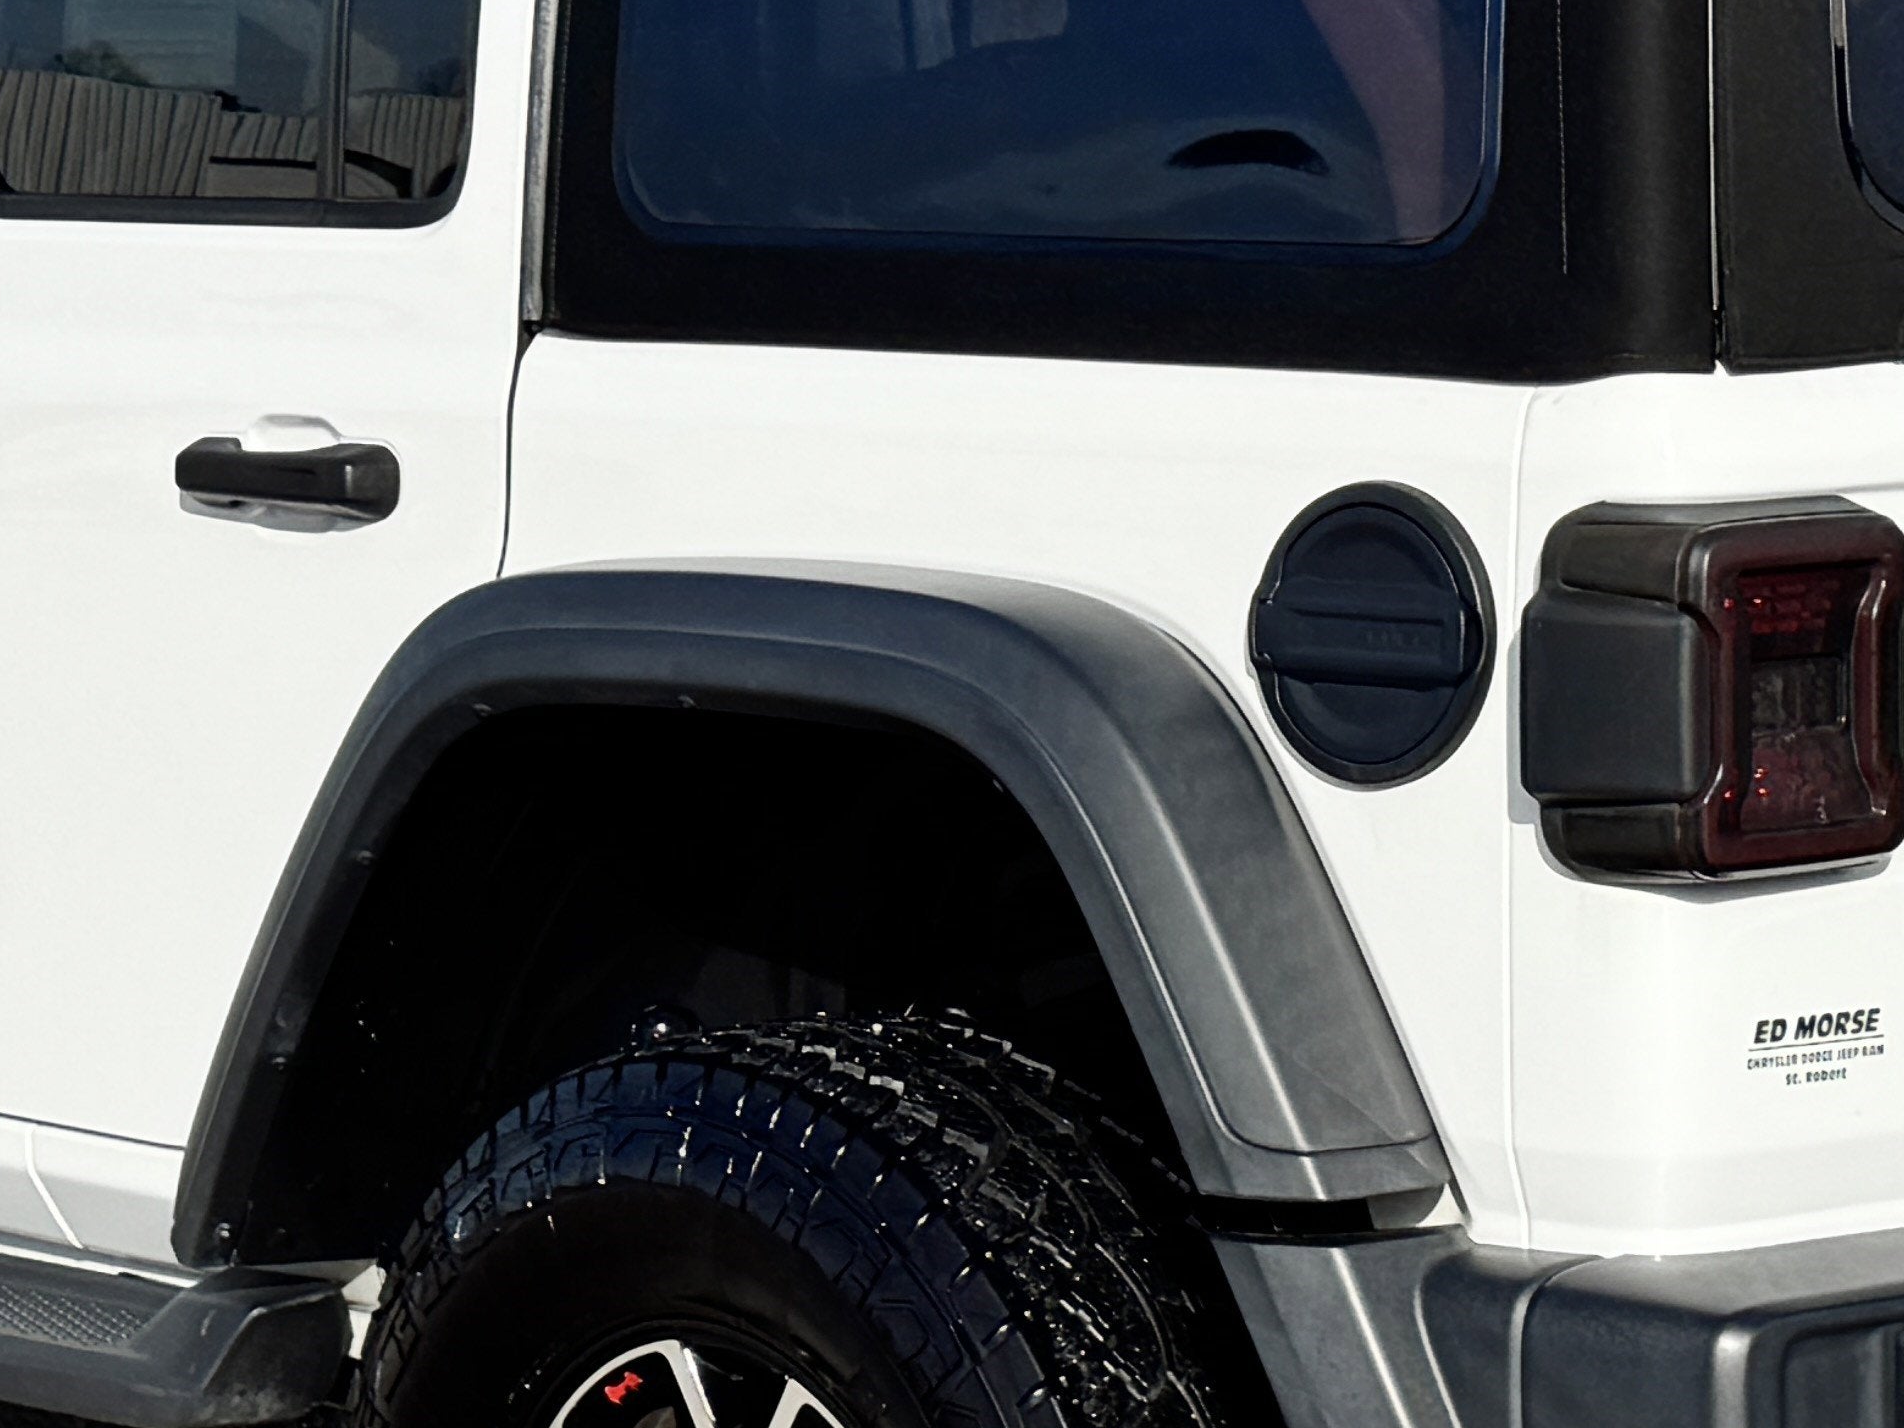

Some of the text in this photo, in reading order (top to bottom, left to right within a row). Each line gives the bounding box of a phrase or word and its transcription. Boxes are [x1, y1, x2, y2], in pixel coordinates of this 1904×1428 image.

[1753, 1007, 1881, 1045] ED MORSE
[1836, 1047, 1860, 1062] JEEP
[1862, 1044, 1885, 1058] RAM
